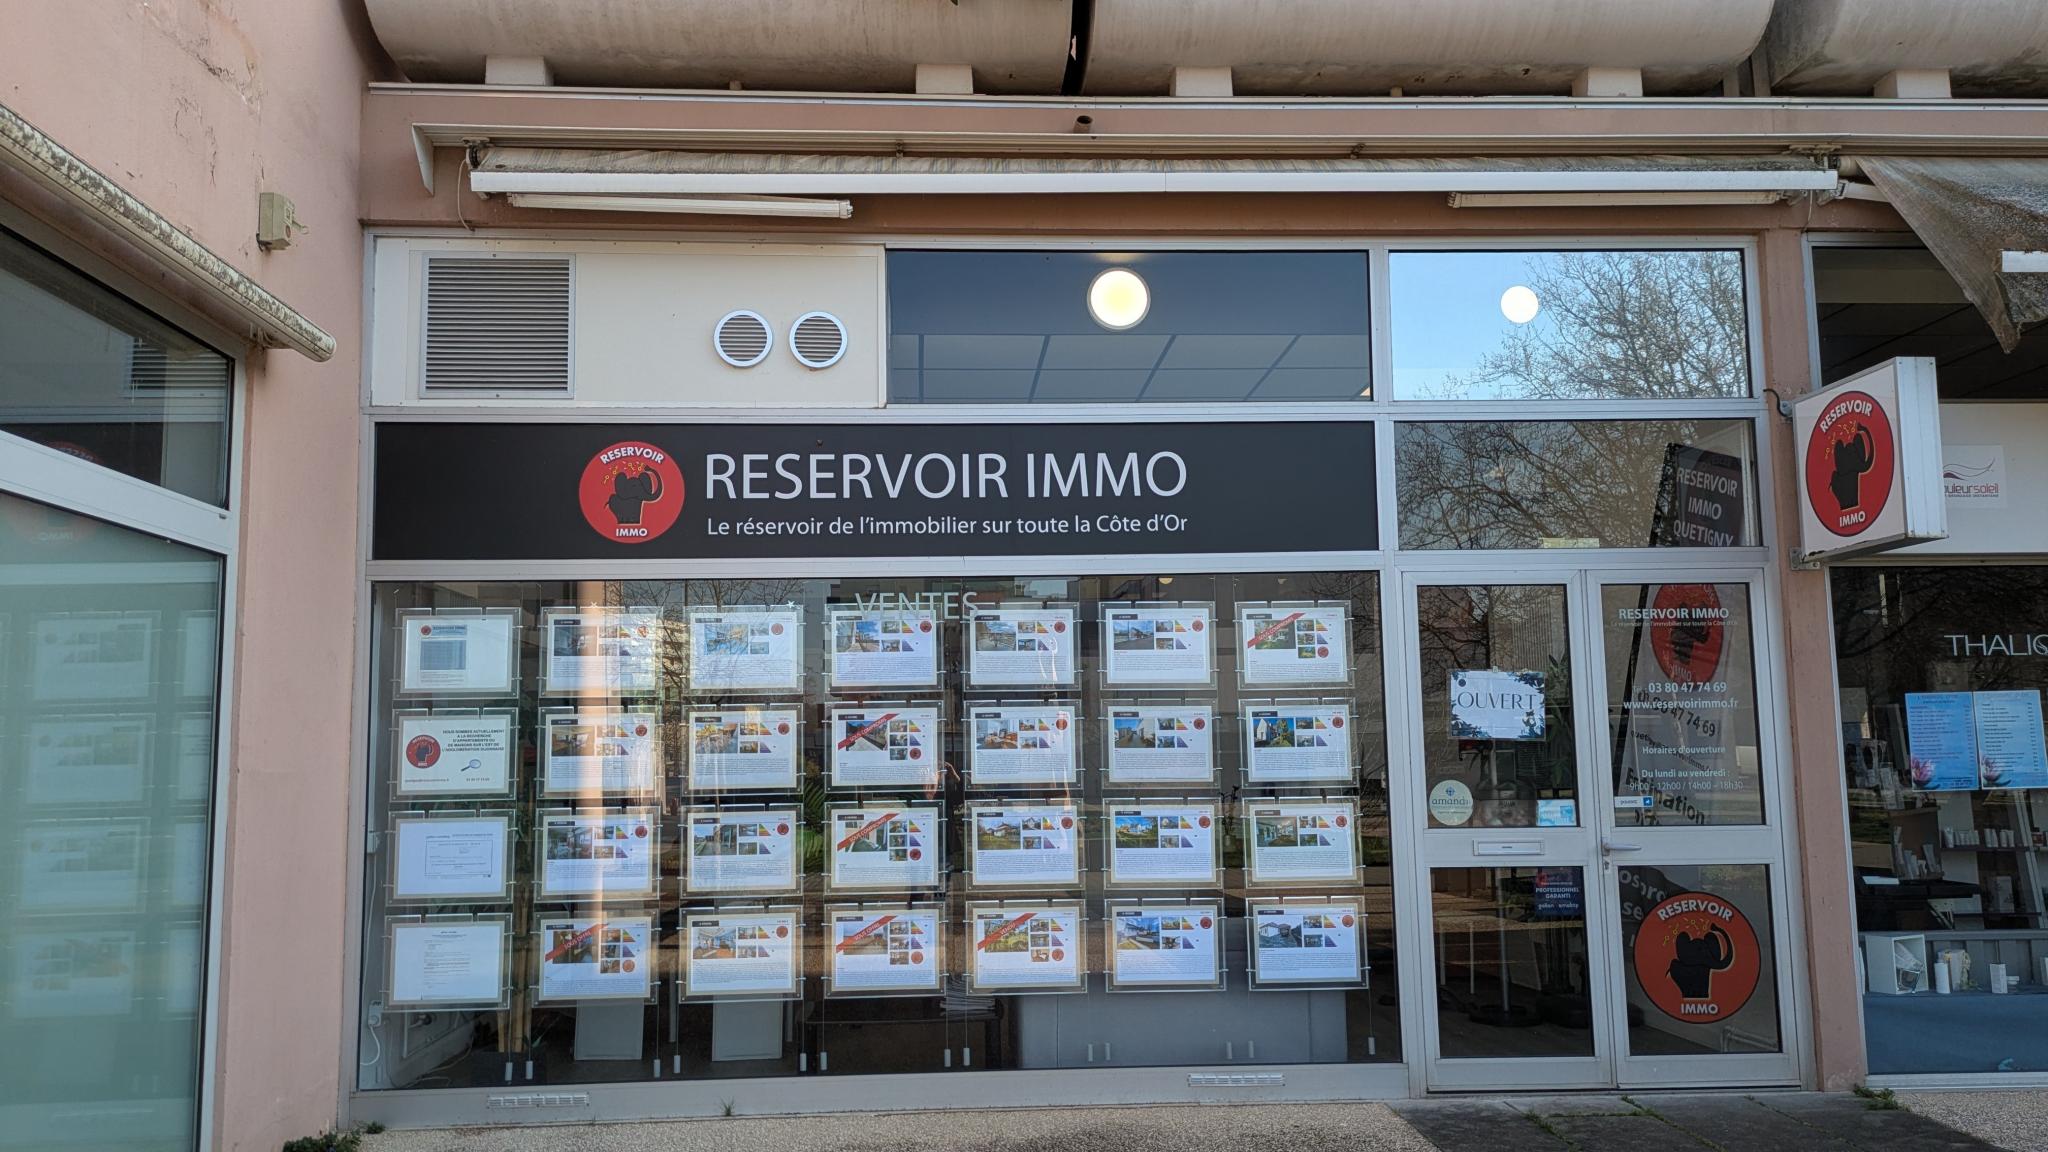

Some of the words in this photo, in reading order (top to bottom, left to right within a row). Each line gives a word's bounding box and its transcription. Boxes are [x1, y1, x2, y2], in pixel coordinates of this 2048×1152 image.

[1820, 400, 1873, 433] RESERVOIR
[600, 446, 665, 465] RESERVOIR
[706, 453, 1009, 499] RESERVOIR
[1026, 451, 1187, 498] IMMO
[1676, 466, 1738, 498] RESERVOIR
[1688, 496, 1722, 520] IMMO
[708, 517, 730, 535] Le
[736, 516, 822, 535] réservoir
[829, 516, 853, 535] de
[860, 515, 977, 535] l'immobilier
[982, 517, 1012, 534] sur
[1017, 516, 1069, 533] toute
[1075, 515, 1091, 533] la
[1096, 514, 1141, 533] Côte
[1146, 514, 1188, 532] d'Or
[1838, 510, 1866, 527] IMMO
[615, 528, 648, 538] IMMO
[1673, 519, 1734, 547] QUETIGNY
[855, 591, 978, 620] VENTES
[1619, 608, 1690, 619] RESERVOIR
[1692, 607, 1730, 619] IMMO
[1648, 682, 1662, 693] 03
[1664, 682, 1678, 693] 80
[1681, 682, 1695, 692] 47
[1697, 682, 1711, 692] 74
[1713, 682, 1727, 692] 69
[1457, 691, 1537, 710] OUVERT
[1623, 698, 1738, 709] www.reservoirimmo.fr
[1642, 746, 1676, 755] Horaires
[1678, 745, 1726, 755] d'ouverture
[1641, 769, 1654, 778] Du
[1655, 769, 1676, 778] lundi
[1690, 769, 1725, 778] vendredi
[1657, 782, 1681, 790] 12h00
[1688, 782, 1711, 790] 14h00
[1657, 900, 1734, 921] RESERVOIR
[1681, 1003, 1719, 1015] IMMO
